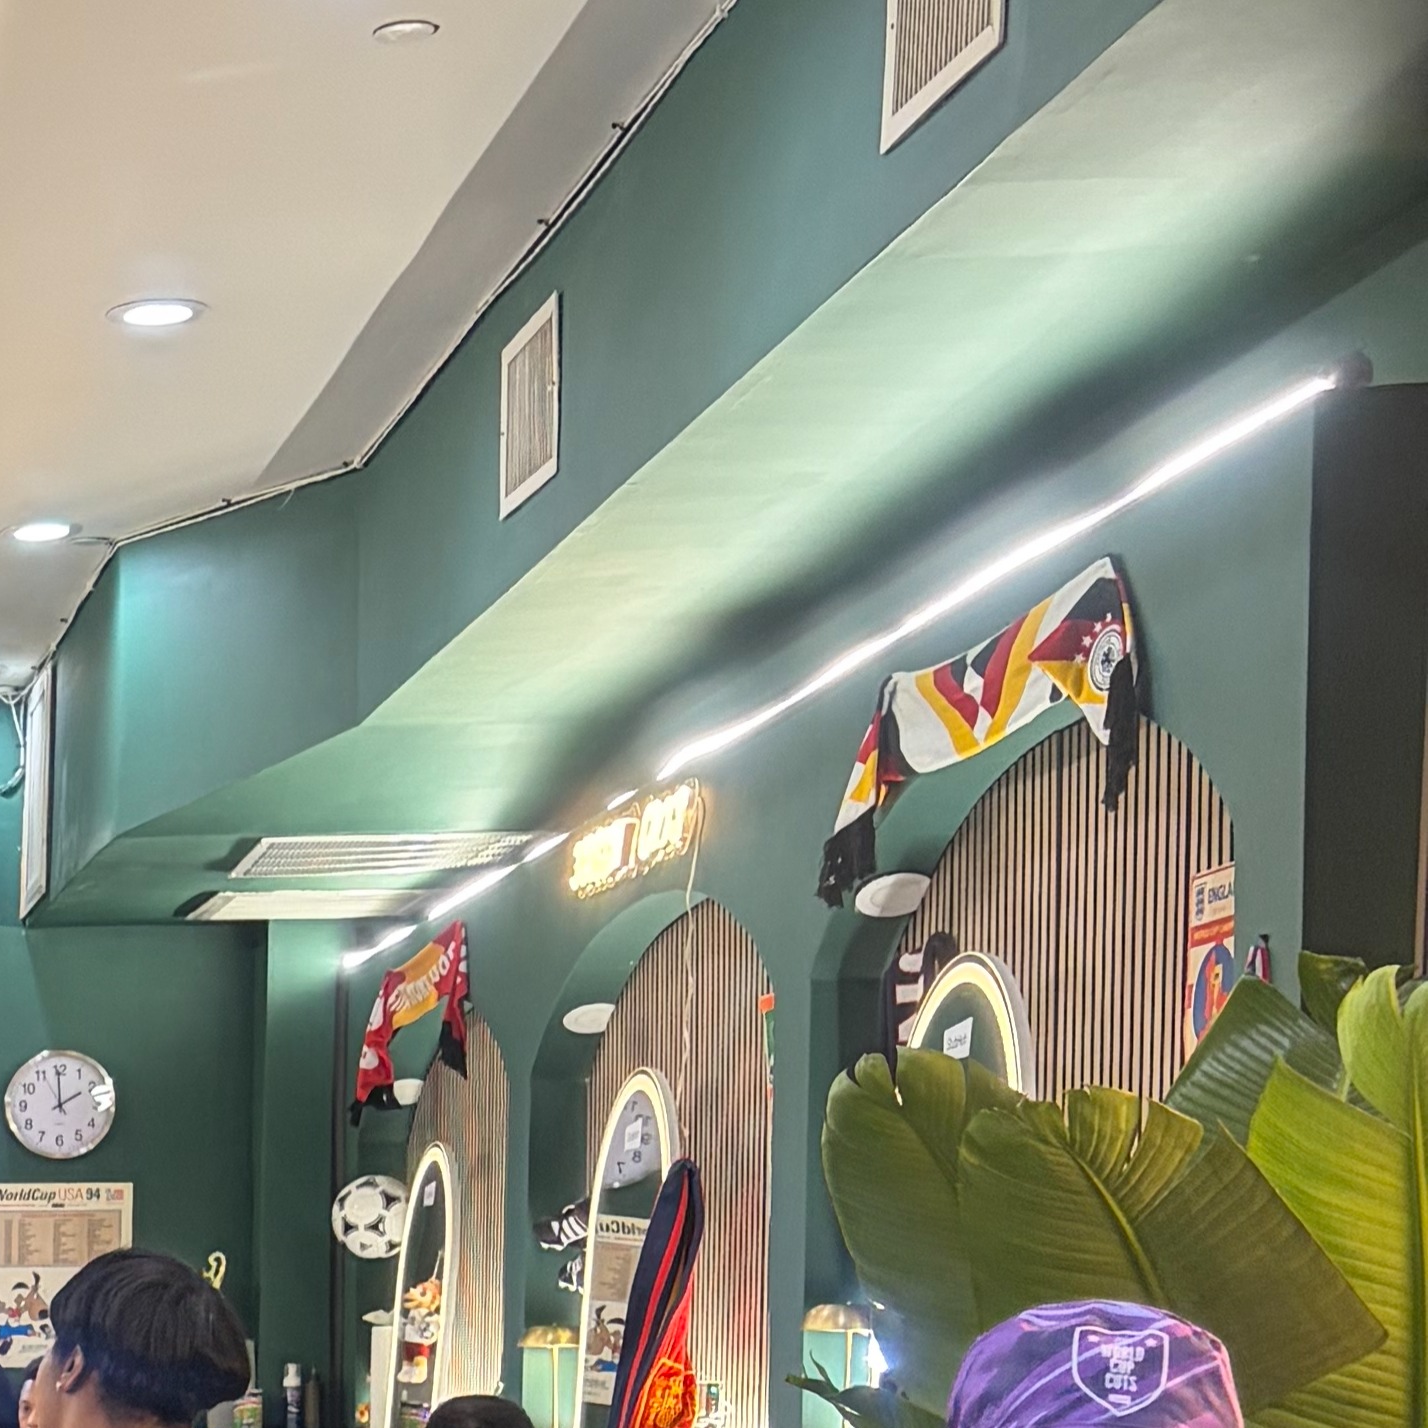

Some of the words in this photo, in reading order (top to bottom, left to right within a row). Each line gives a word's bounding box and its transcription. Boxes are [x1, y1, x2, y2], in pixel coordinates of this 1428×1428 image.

[35, 1070, 46, 1081] 11
[77, 1068, 82, 1080] 1
[23, 1082, 35, 1095] 10
[19, 1100, 27, 1112] 9
[25, 1118, 33, 1131] 8
[87, 1117, 95, 1128] 4
[38, 1131, 45, 1142] 7
[55, 1134, 64, 1147] 6
[75, 1129, 83, 1141] 5
[58, 1188, 84, 1201] USA
[86, 1188, 100, 1201] 94
